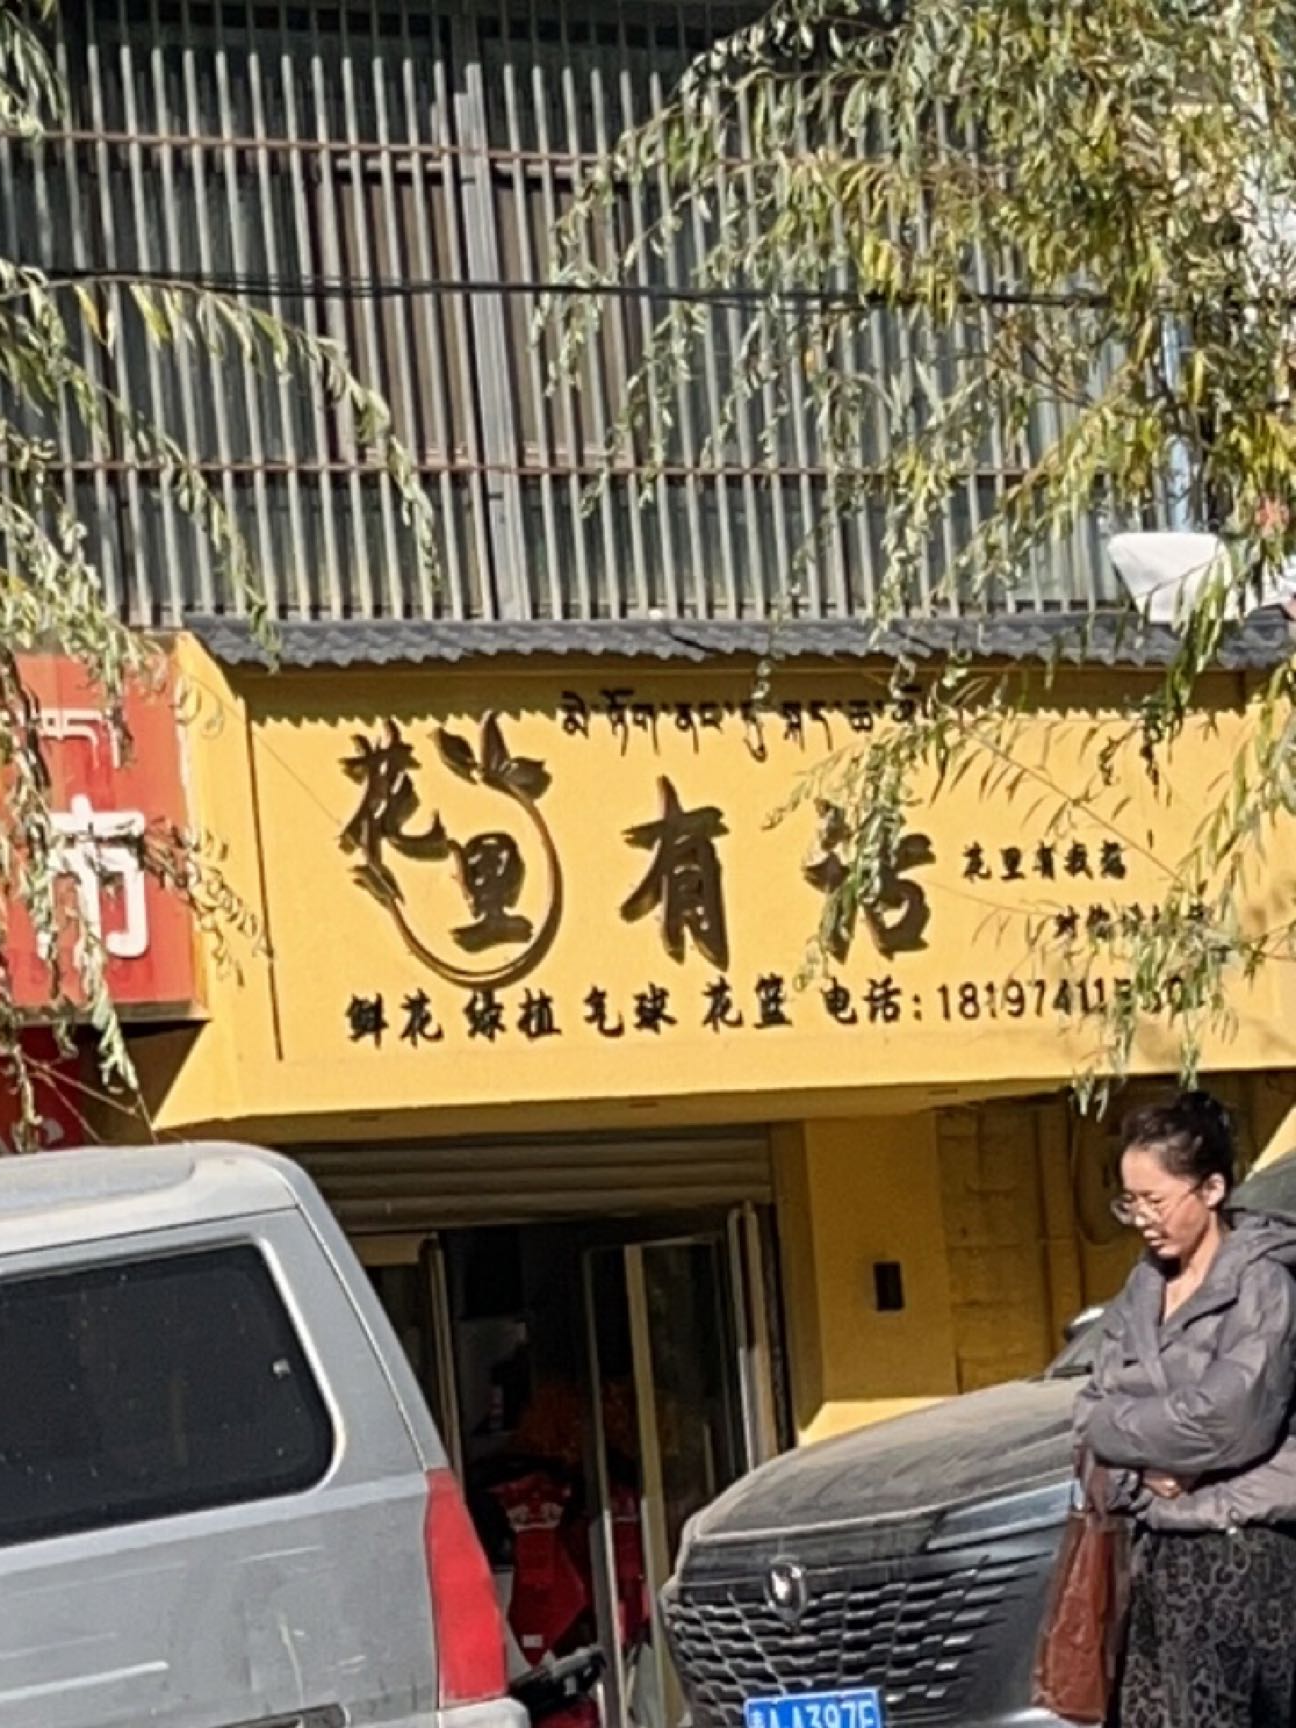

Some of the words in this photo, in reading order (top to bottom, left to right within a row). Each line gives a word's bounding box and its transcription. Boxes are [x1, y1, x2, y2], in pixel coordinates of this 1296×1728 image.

[345, 988, 444, 1049] 鲜花
[462, 986, 562, 1043] 绿植
[584, 981, 678, 1038] 气球
[701, 973, 793, 1030] 花篮
